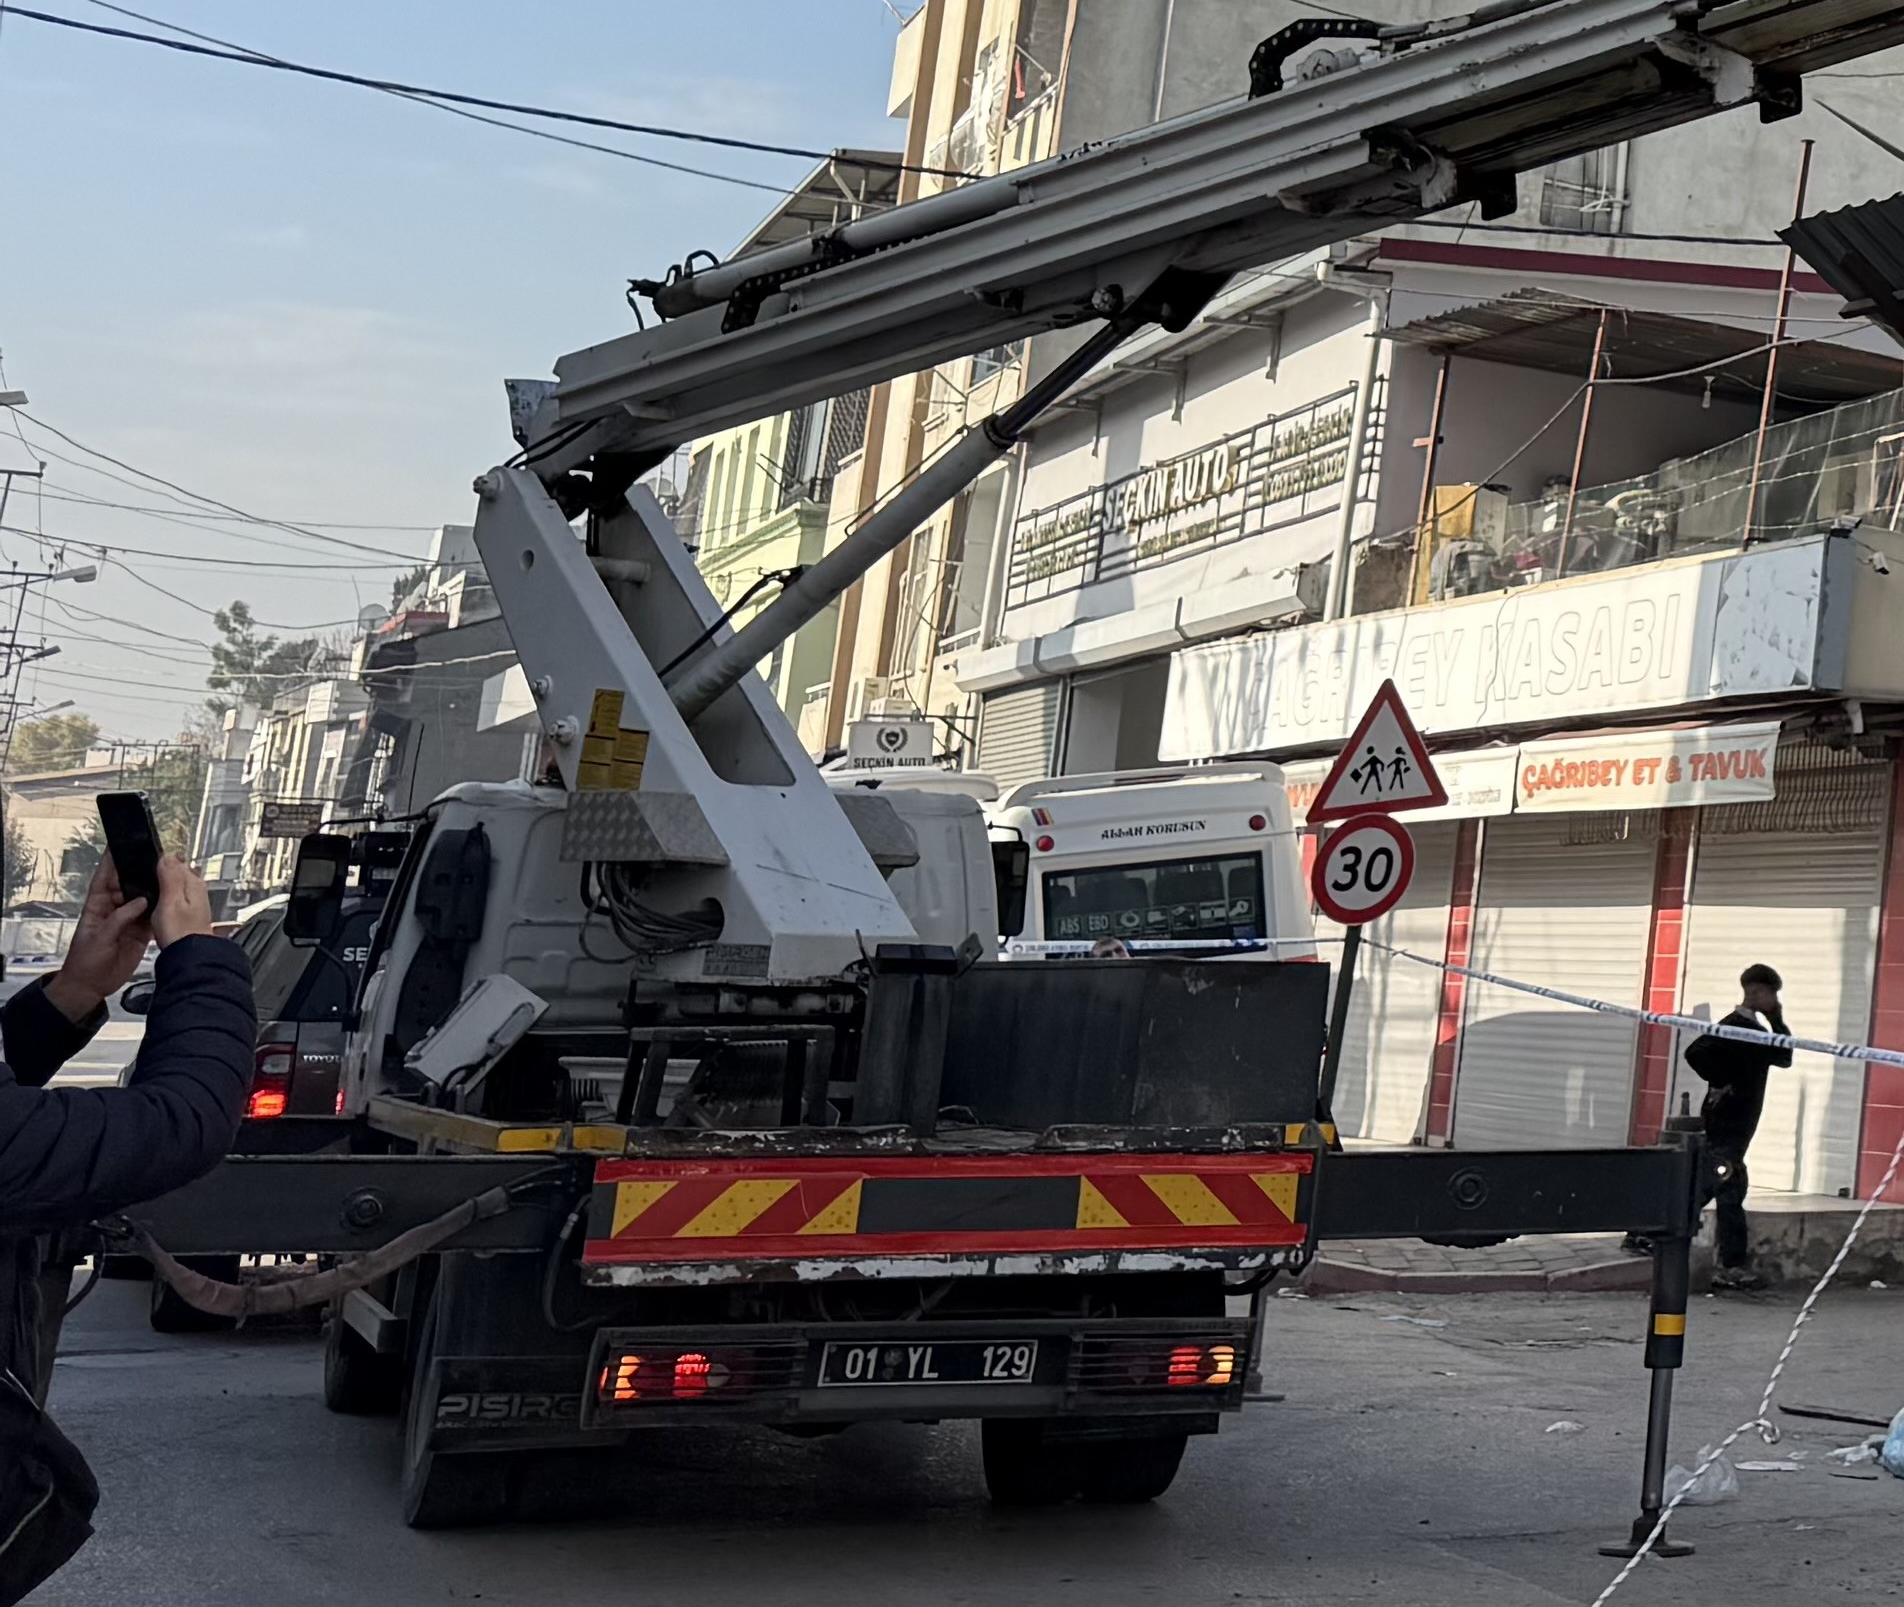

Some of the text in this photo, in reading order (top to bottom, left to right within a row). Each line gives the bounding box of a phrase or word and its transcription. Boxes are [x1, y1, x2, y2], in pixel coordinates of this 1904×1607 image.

[1170, 444, 1230, 510] AUTO
[1475, 594, 1681, 704] KASABI
[1522, 757, 1629, 798] ÇAĞRIBEY
[1632, 757, 1663, 786] ET
[1665, 755, 1682, 784] &
[1688, 748, 1768, 782] TAVUK
[1101, 820, 1206, 840] ALLAH KORUSUN
[1331, 846, 1394, 893] 30
[1060, 917, 1080, 934] ABS
[303, 1054, 342, 1064] TOYOT
[845, 1346, 1030, 1380] 01 YL 129
